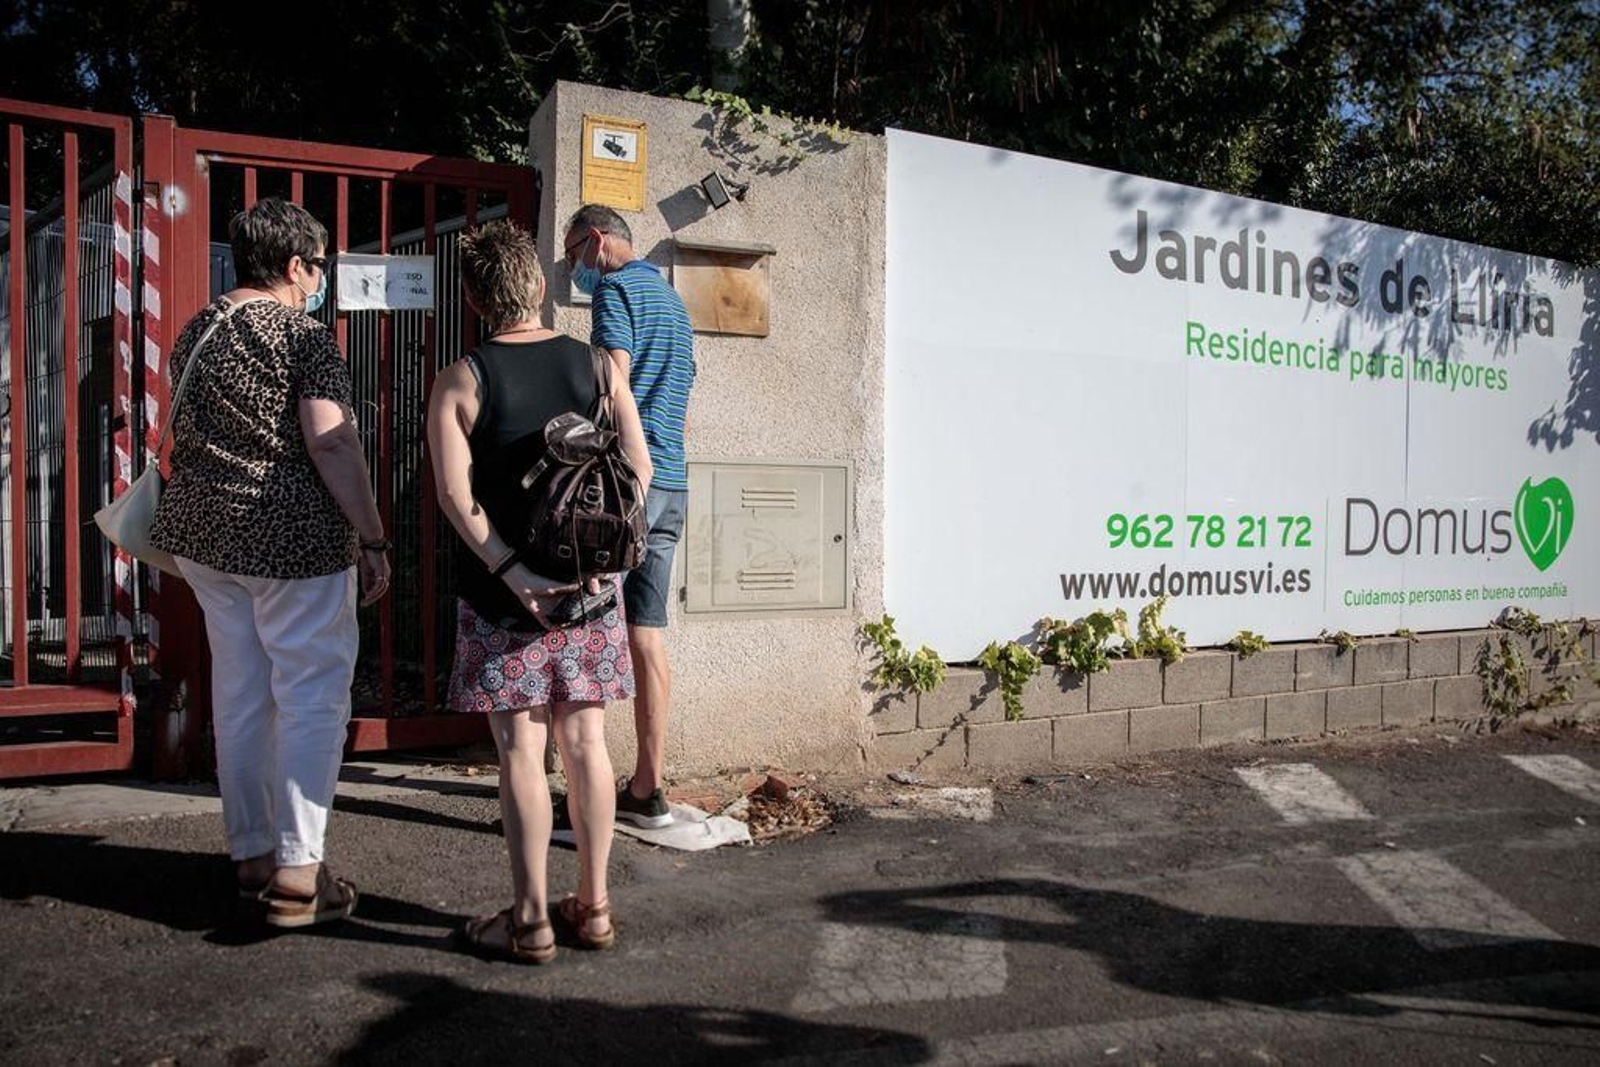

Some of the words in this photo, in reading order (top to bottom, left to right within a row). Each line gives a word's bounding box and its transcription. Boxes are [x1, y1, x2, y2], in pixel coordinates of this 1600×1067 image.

[1109, 209, 1361, 308] Jardines
[1379, 257, 1432, 319] de
[1186, 321, 1341, 373] Residencia
[1349, 349, 1405, 382] para
[1412, 356, 1508, 393] mayores
[1106, 513, 1174, 549] 962
[1186, 514, 1226, 549] 78
[1236, 515, 1267, 548] 21
[1277, 515, 1312, 548] 72
[1059, 561, 1311, 601] www.domusvi.es
[1343, 588, 1405, 607] Cuidamos
[1408, 587, 1462, 606] personas
[1465, 588, 1479, 600] en
[1482, 584, 1515, 600] buena
[1517, 582, 1568, 599] compañía
